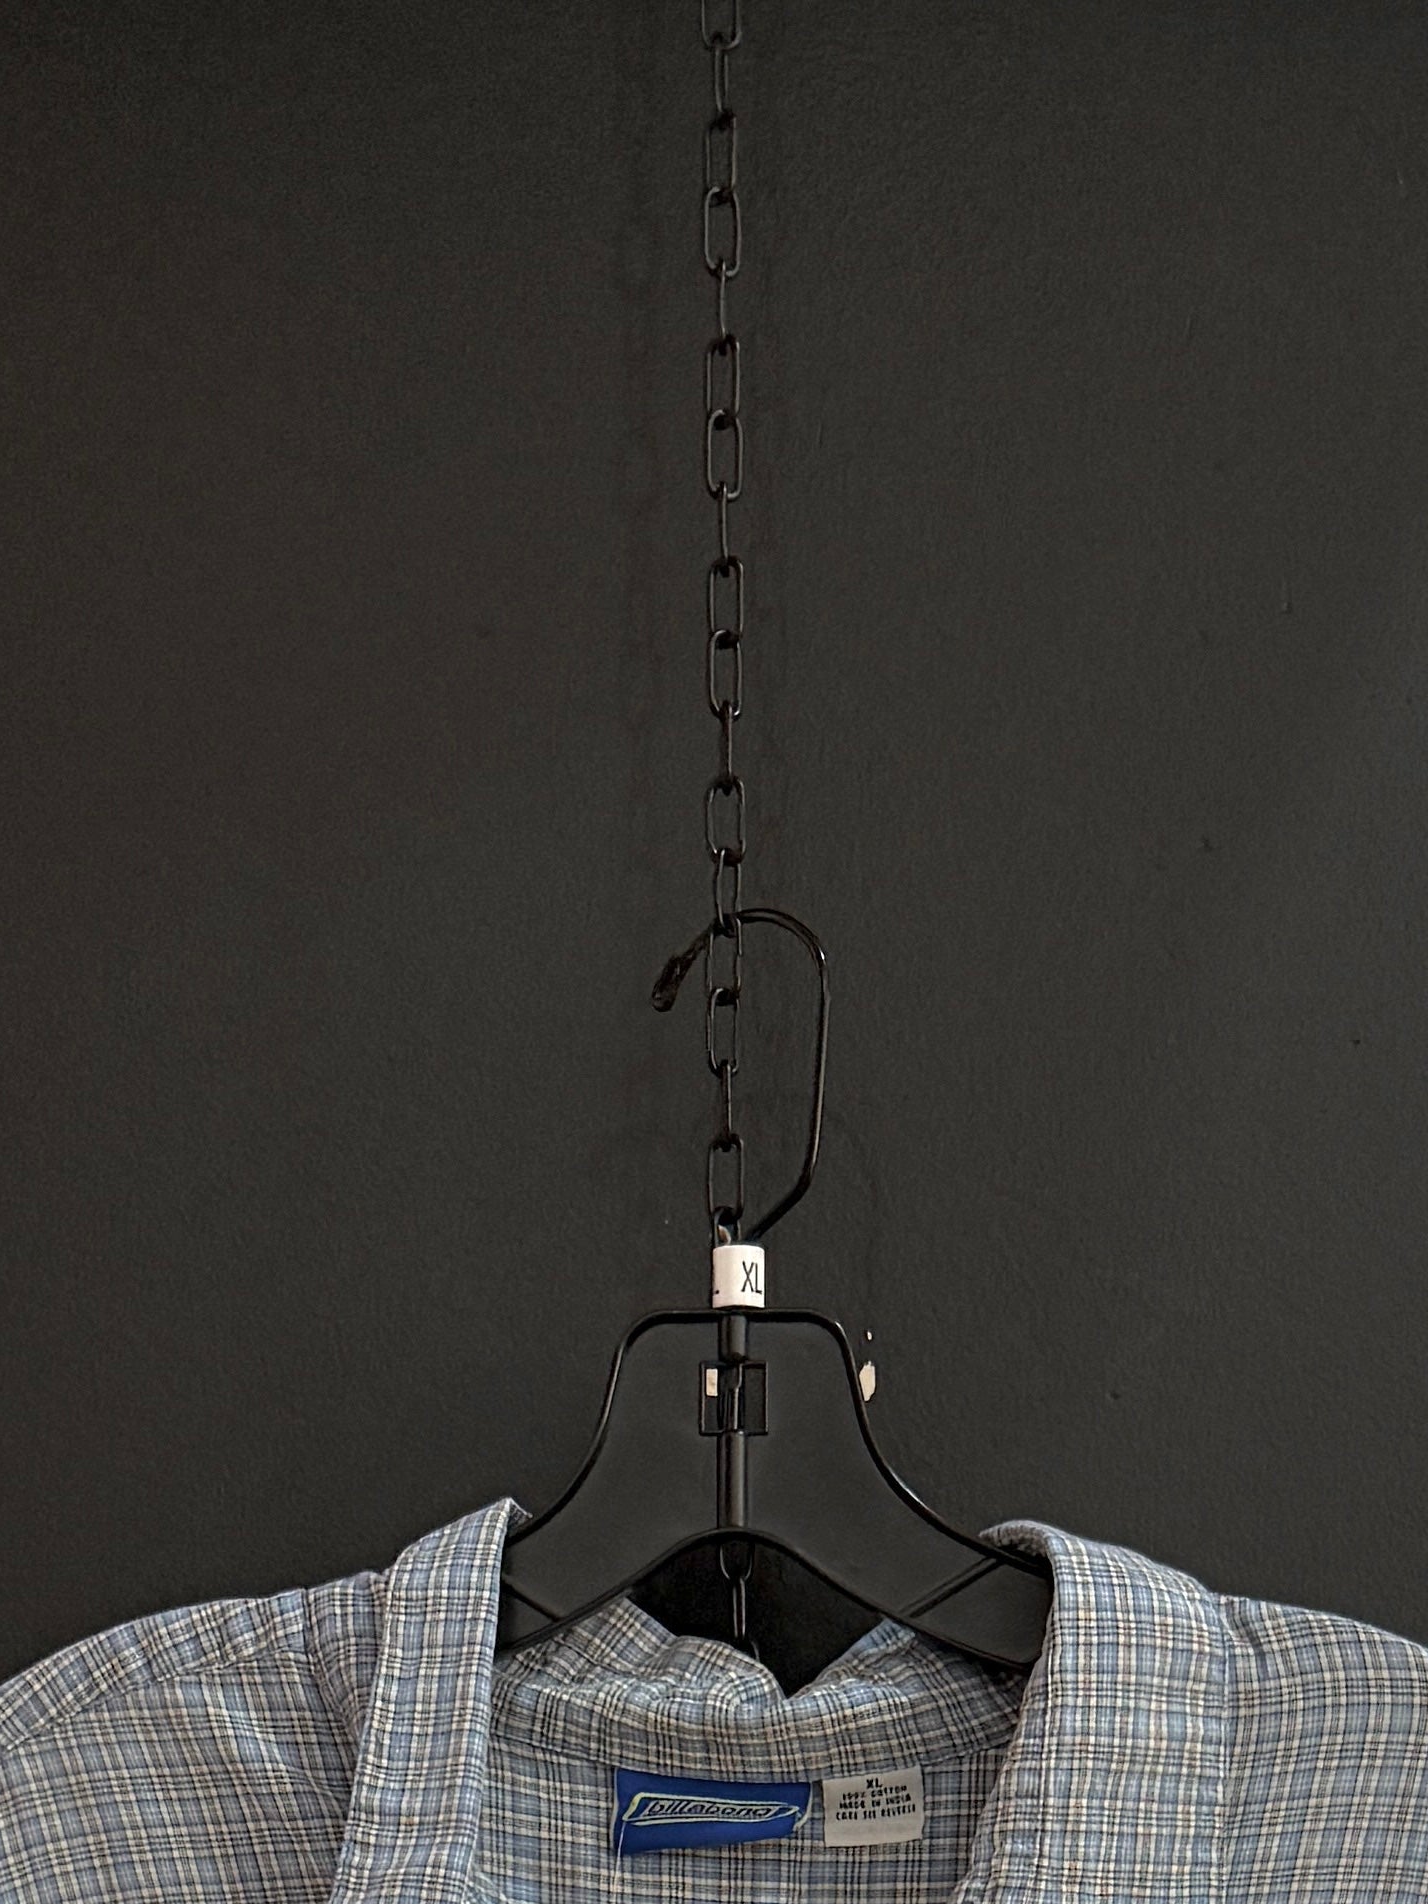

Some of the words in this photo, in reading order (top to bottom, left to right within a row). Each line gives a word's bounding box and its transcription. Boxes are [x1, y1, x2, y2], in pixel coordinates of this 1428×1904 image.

[740, 1259, 763, 1295] XL
[866, 1777, 884, 1790] XL
[871, 1799, 881, 1808] IN
[885, 1793, 912, 1805] INDIA
